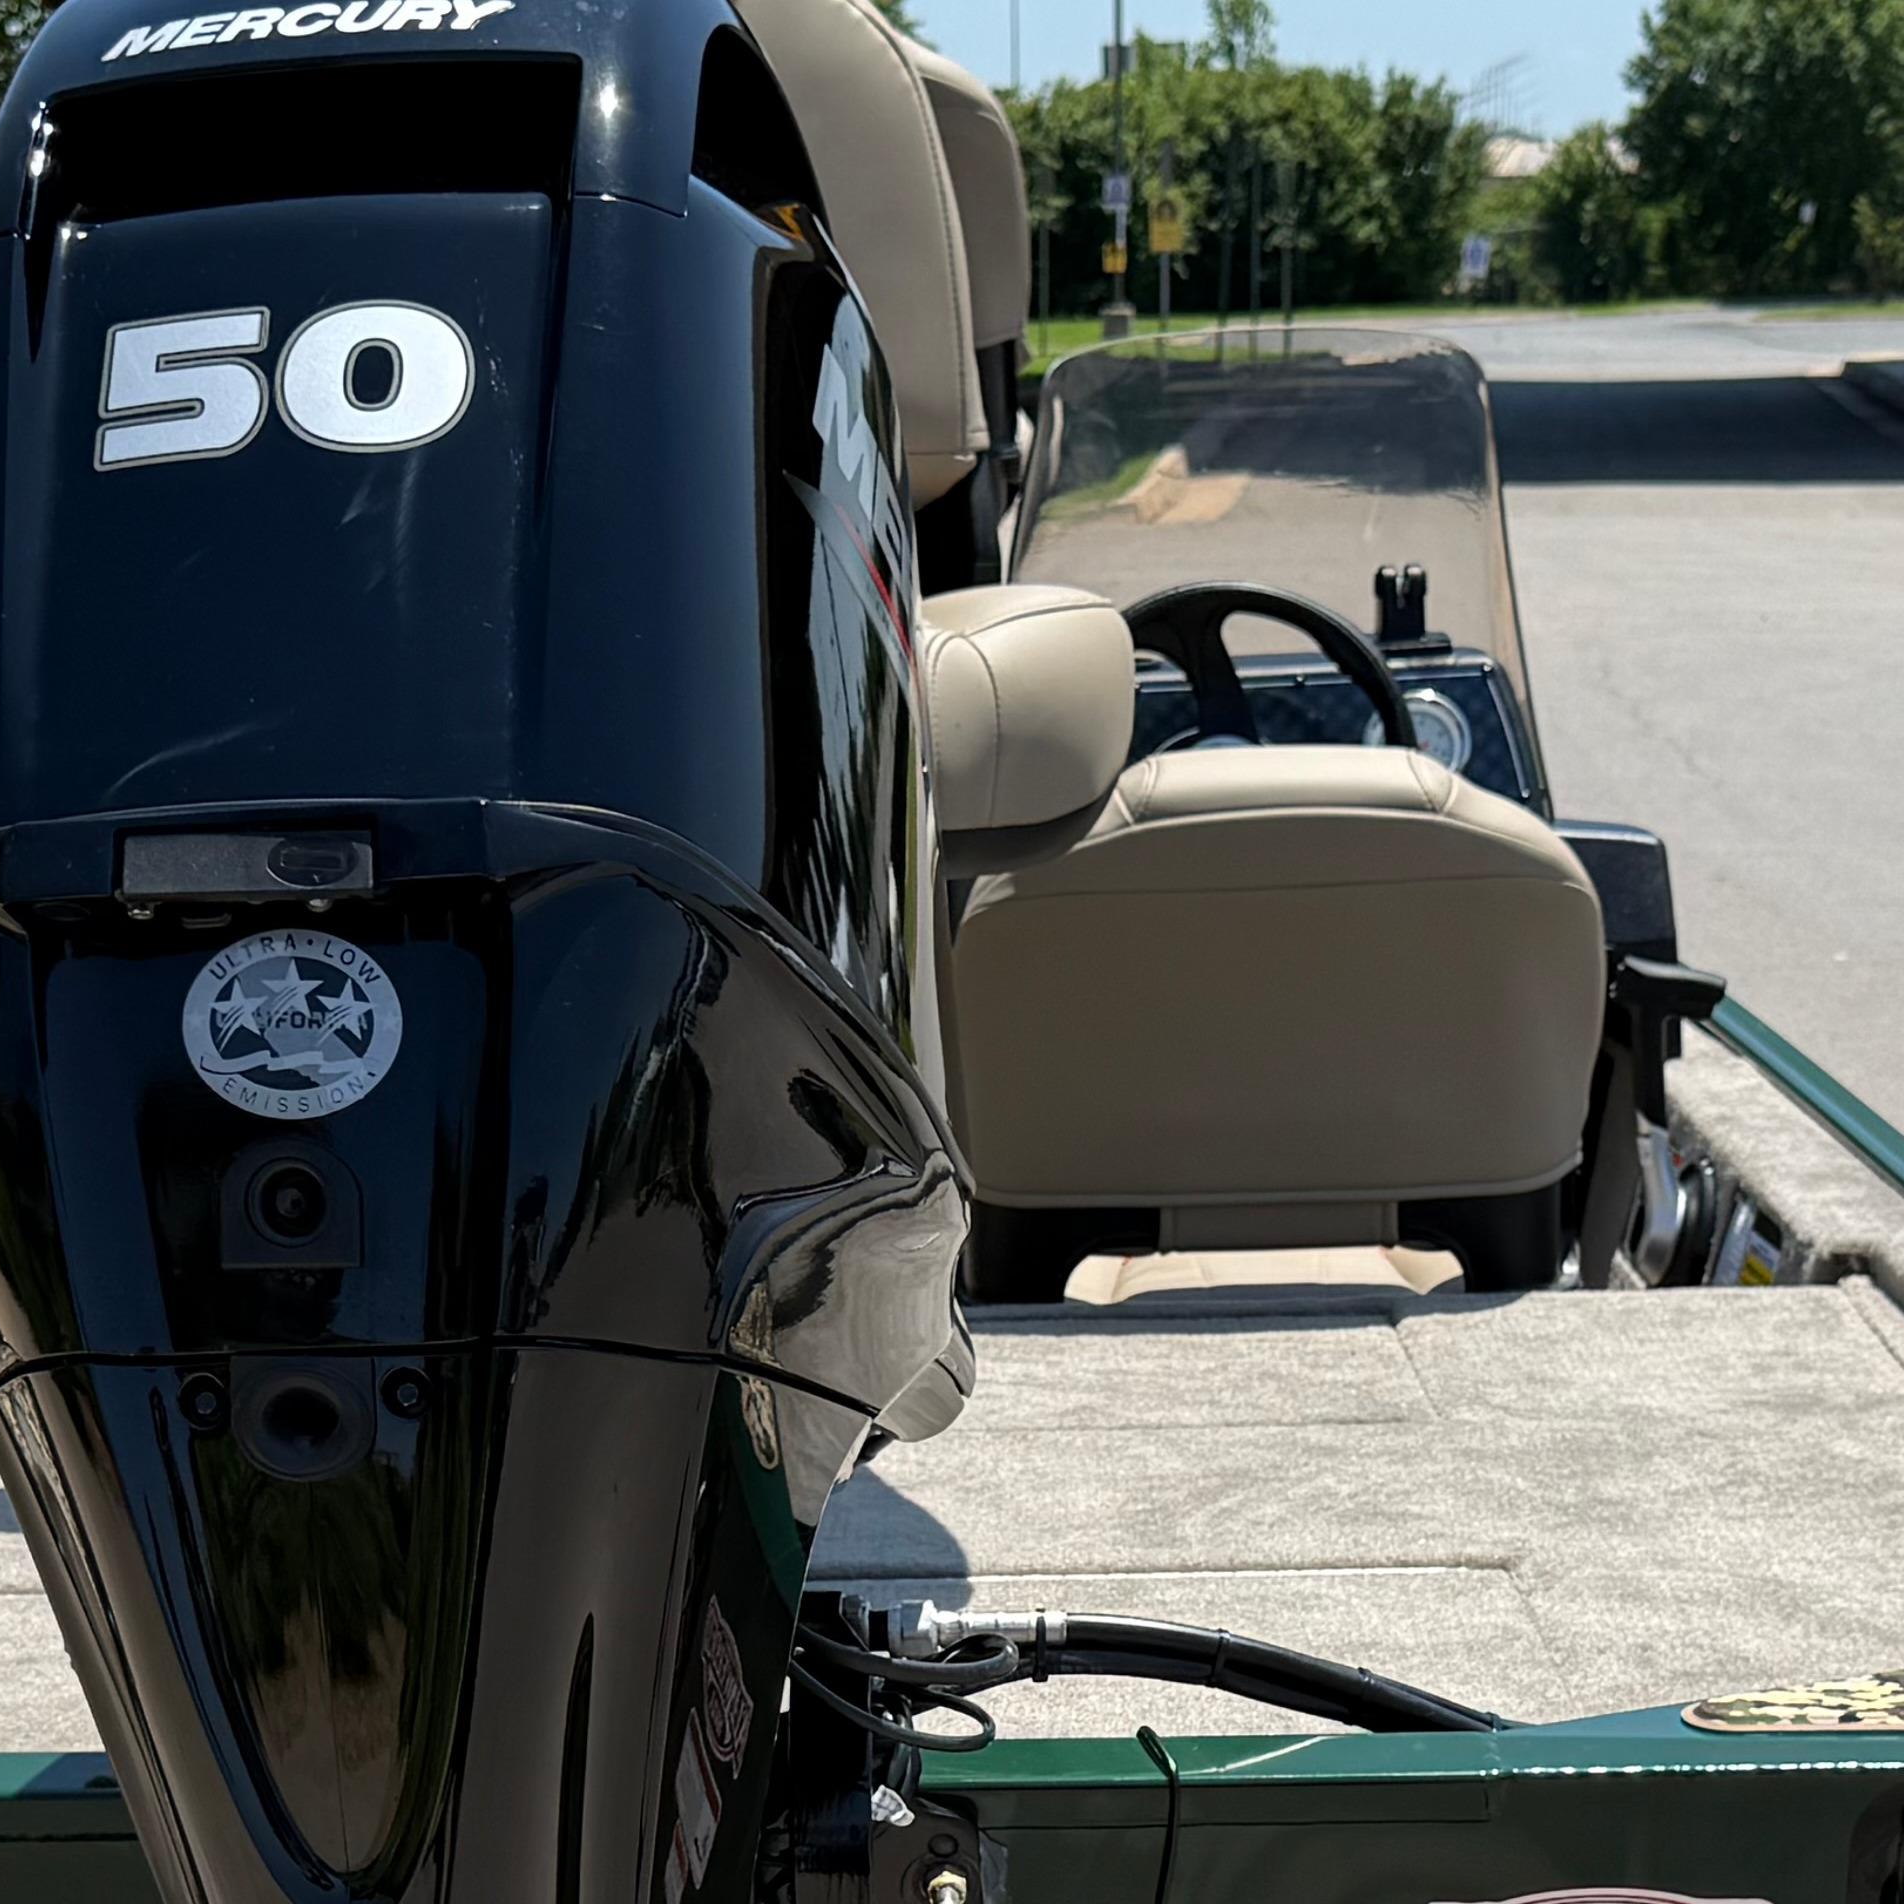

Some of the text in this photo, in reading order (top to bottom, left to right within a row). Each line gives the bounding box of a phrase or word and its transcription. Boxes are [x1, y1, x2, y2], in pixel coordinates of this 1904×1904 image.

[101, 0, 517, 63] MERCURY
[94, 300, 476, 473] 50
[209, 933, 381, 984] ULTRA LOW
[221, 1076, 365, 1114] EMISSION
